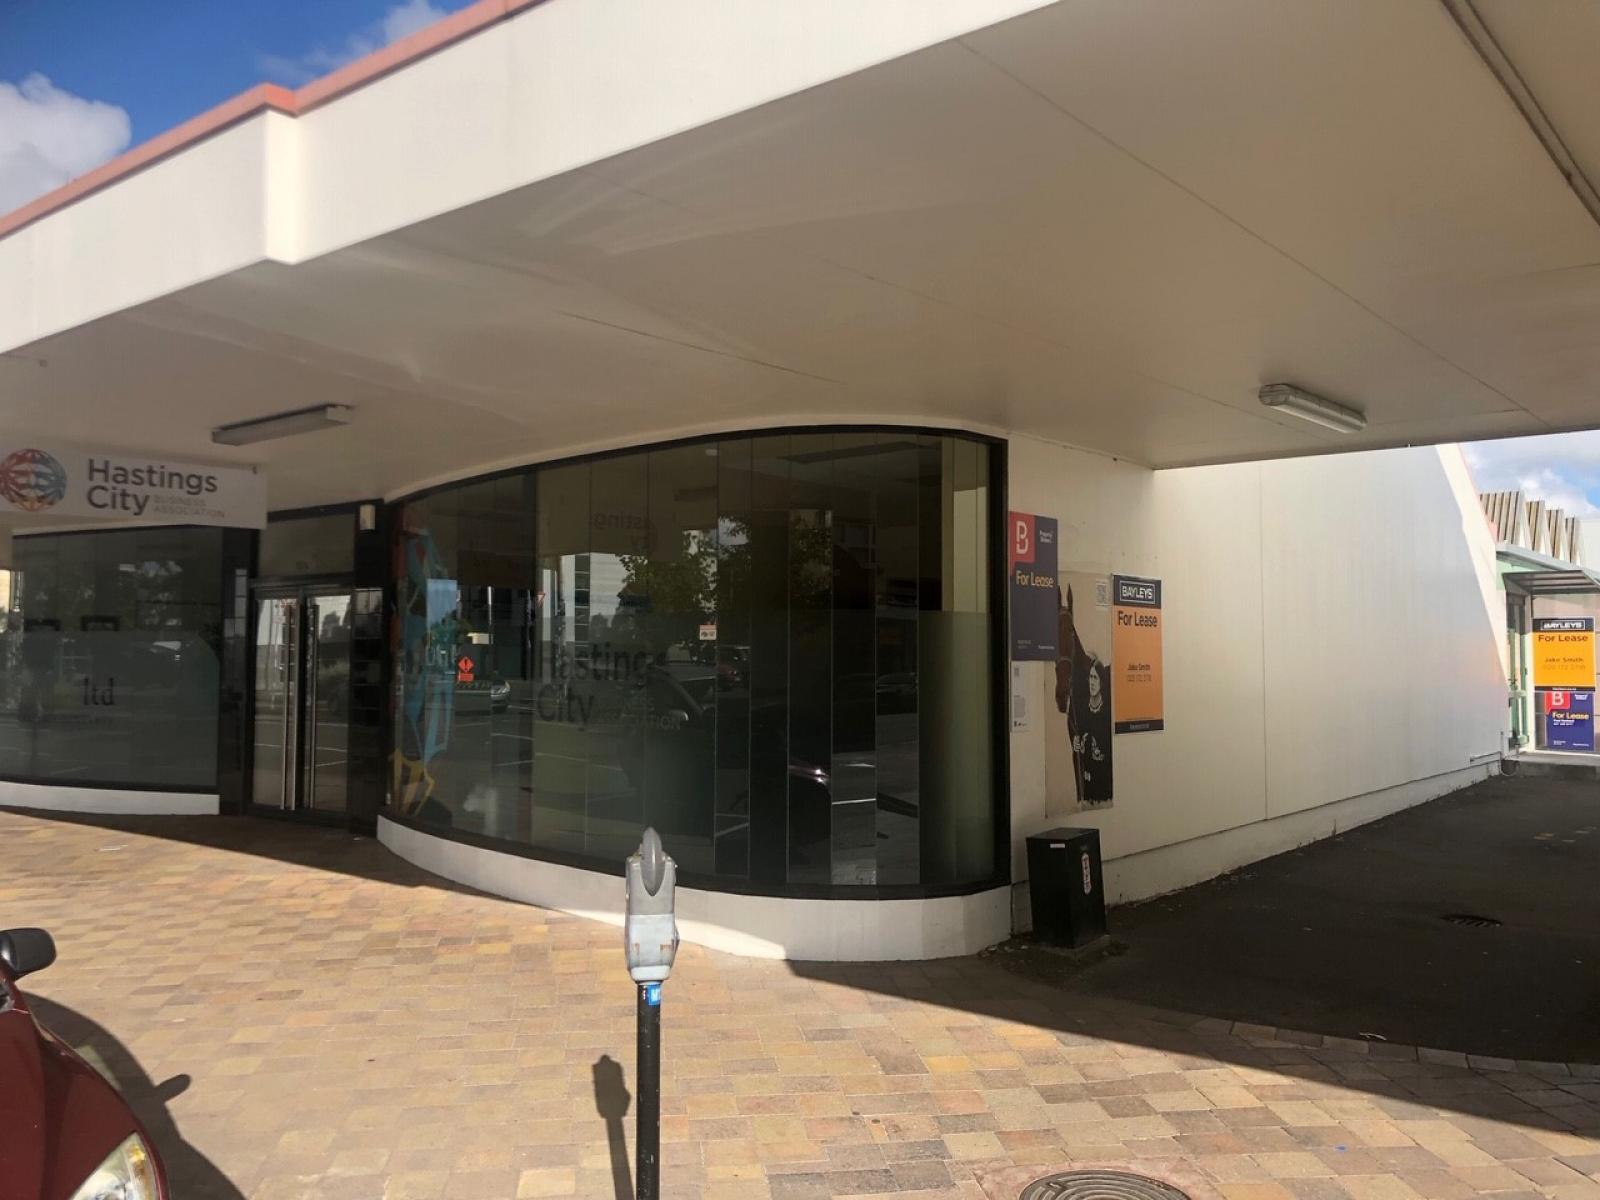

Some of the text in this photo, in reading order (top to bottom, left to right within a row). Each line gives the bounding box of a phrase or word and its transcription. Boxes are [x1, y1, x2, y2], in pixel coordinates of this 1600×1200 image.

[88, 458, 218, 496] Hastings
[86, 485, 151, 517] City
[1015, 520, 1029, 555] B
[1015, 569, 1055, 589] For Lease
[1121, 585, 1153, 600] BAYLEYS
[1117, 610, 1158, 627] For Lease
[1538, 634, 1588, 642] For Lease
[536, 684, 596, 731] City
[1566, 712, 1589, 720] Lease
